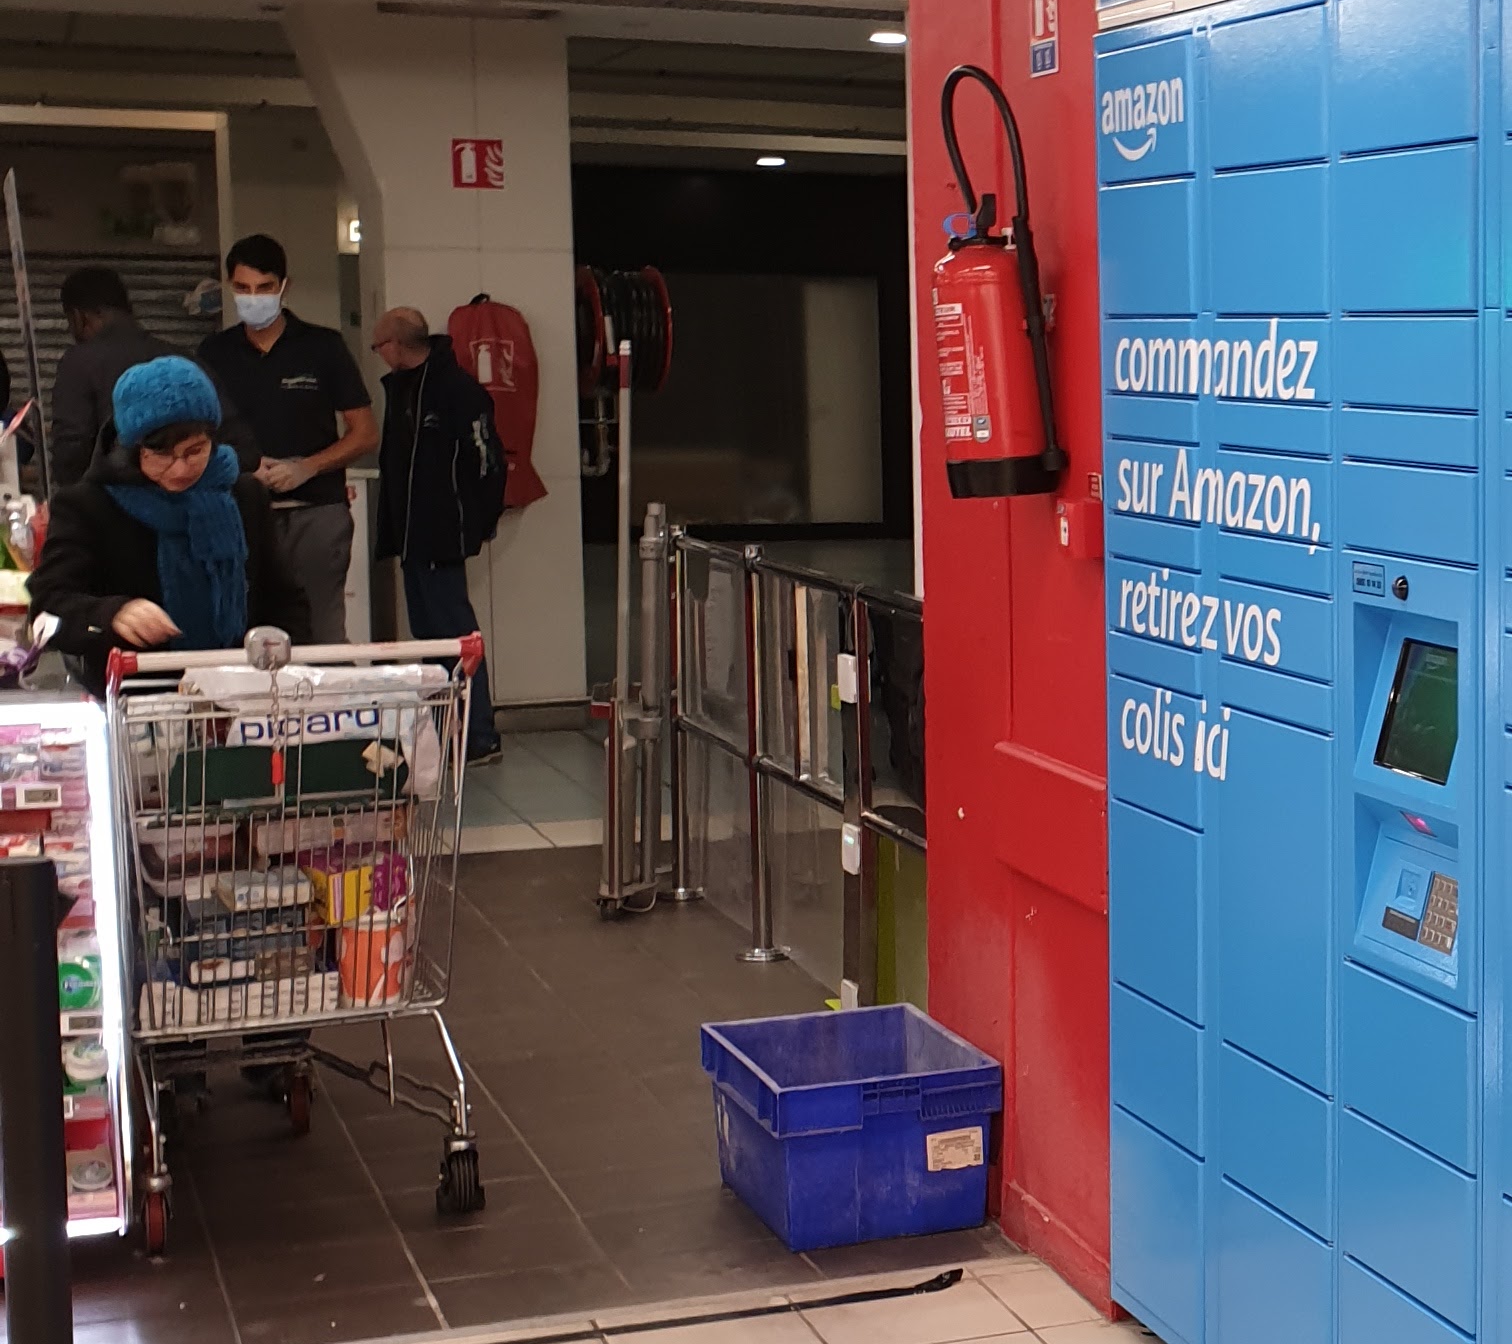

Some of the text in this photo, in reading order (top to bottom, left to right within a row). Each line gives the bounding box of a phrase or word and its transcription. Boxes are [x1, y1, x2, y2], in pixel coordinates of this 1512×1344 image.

[1102, 77, 1184, 135] amazon
[1114, 318, 1318, 400] commandez
[1117, 447, 1321, 555] sur Amazon,
[1120, 568, 1281, 666] retirez vos
[1121, 688, 1232, 781] colis ici
